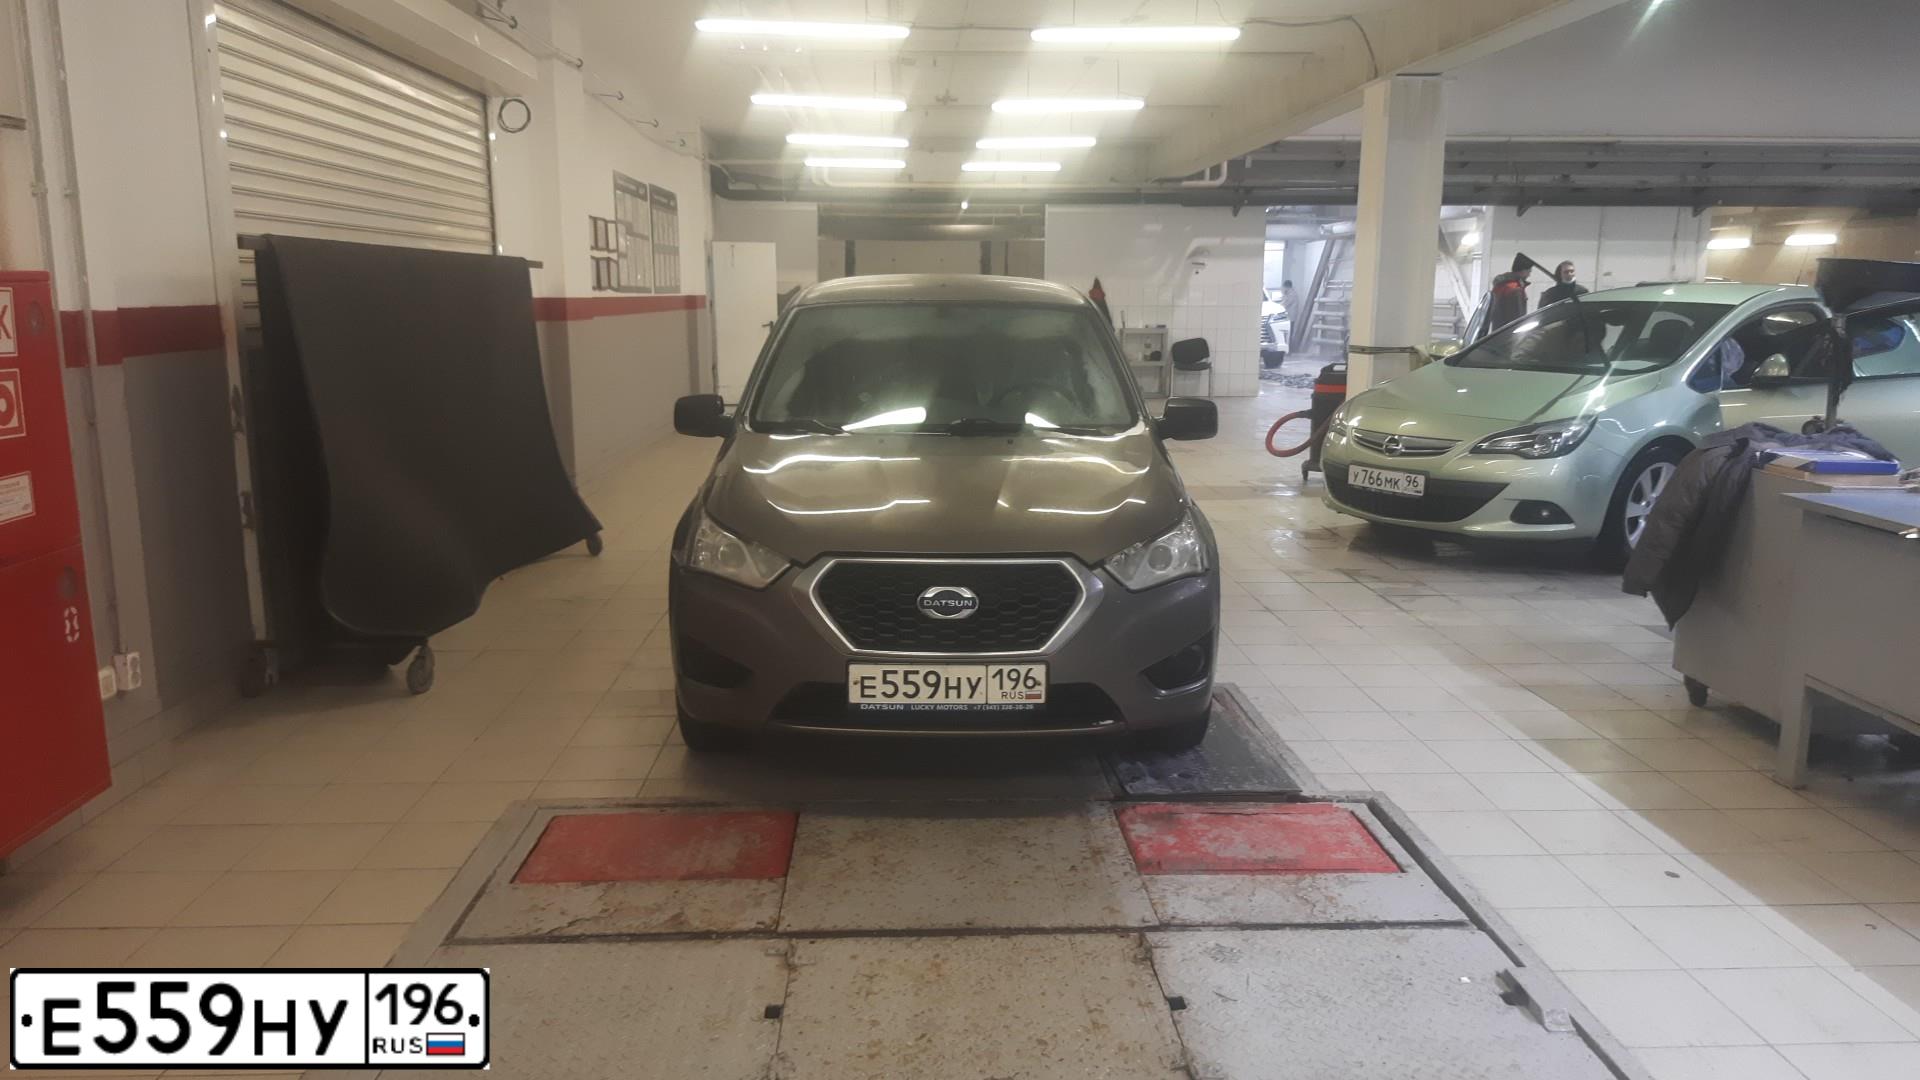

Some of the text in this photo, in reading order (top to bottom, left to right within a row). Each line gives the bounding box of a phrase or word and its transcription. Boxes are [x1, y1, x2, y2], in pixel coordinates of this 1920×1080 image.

[1405, 475, 1419, 488] 96
[923, 599, 973, 607] DATSUN
[992, 667, 1037, 690] 196
[1001, 691, 1024, 700] RUS
